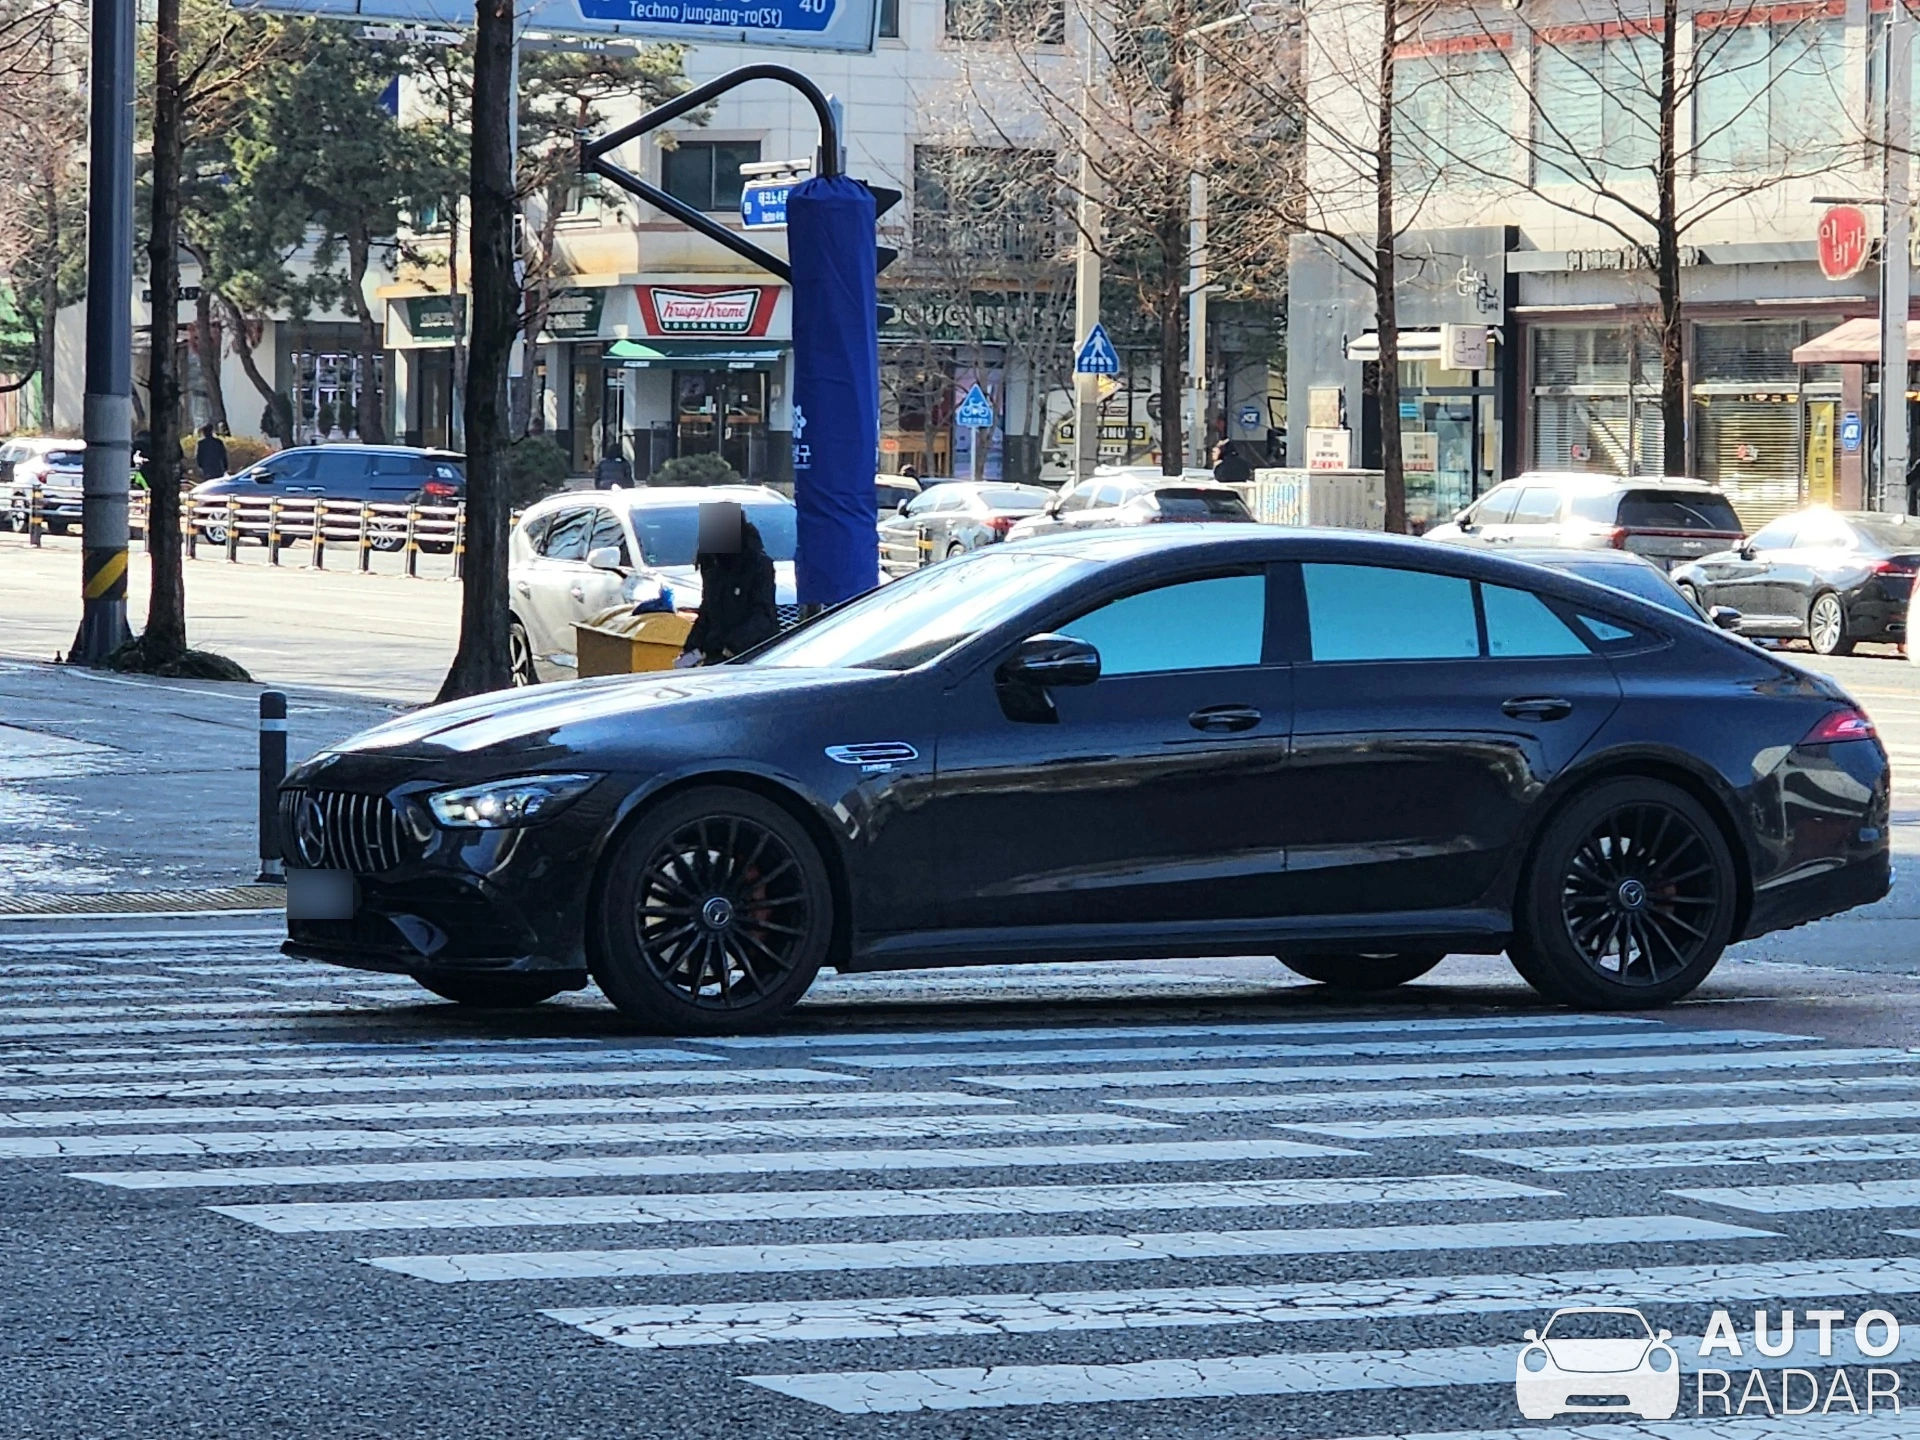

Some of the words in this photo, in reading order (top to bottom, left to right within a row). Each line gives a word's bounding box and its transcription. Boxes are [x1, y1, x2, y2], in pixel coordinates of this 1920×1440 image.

[629, 0, 679, 19] Techno
[681, 3, 783, 27] jungang-ro(St)
[799, 0, 826, 13] 40
[1821, 219, 1866, 267] 이비가
[663, 301, 705, 320] Krispy
[703, 301, 747, 318] Kreme
[664, 322, 747, 330] DOUGHNUTS
